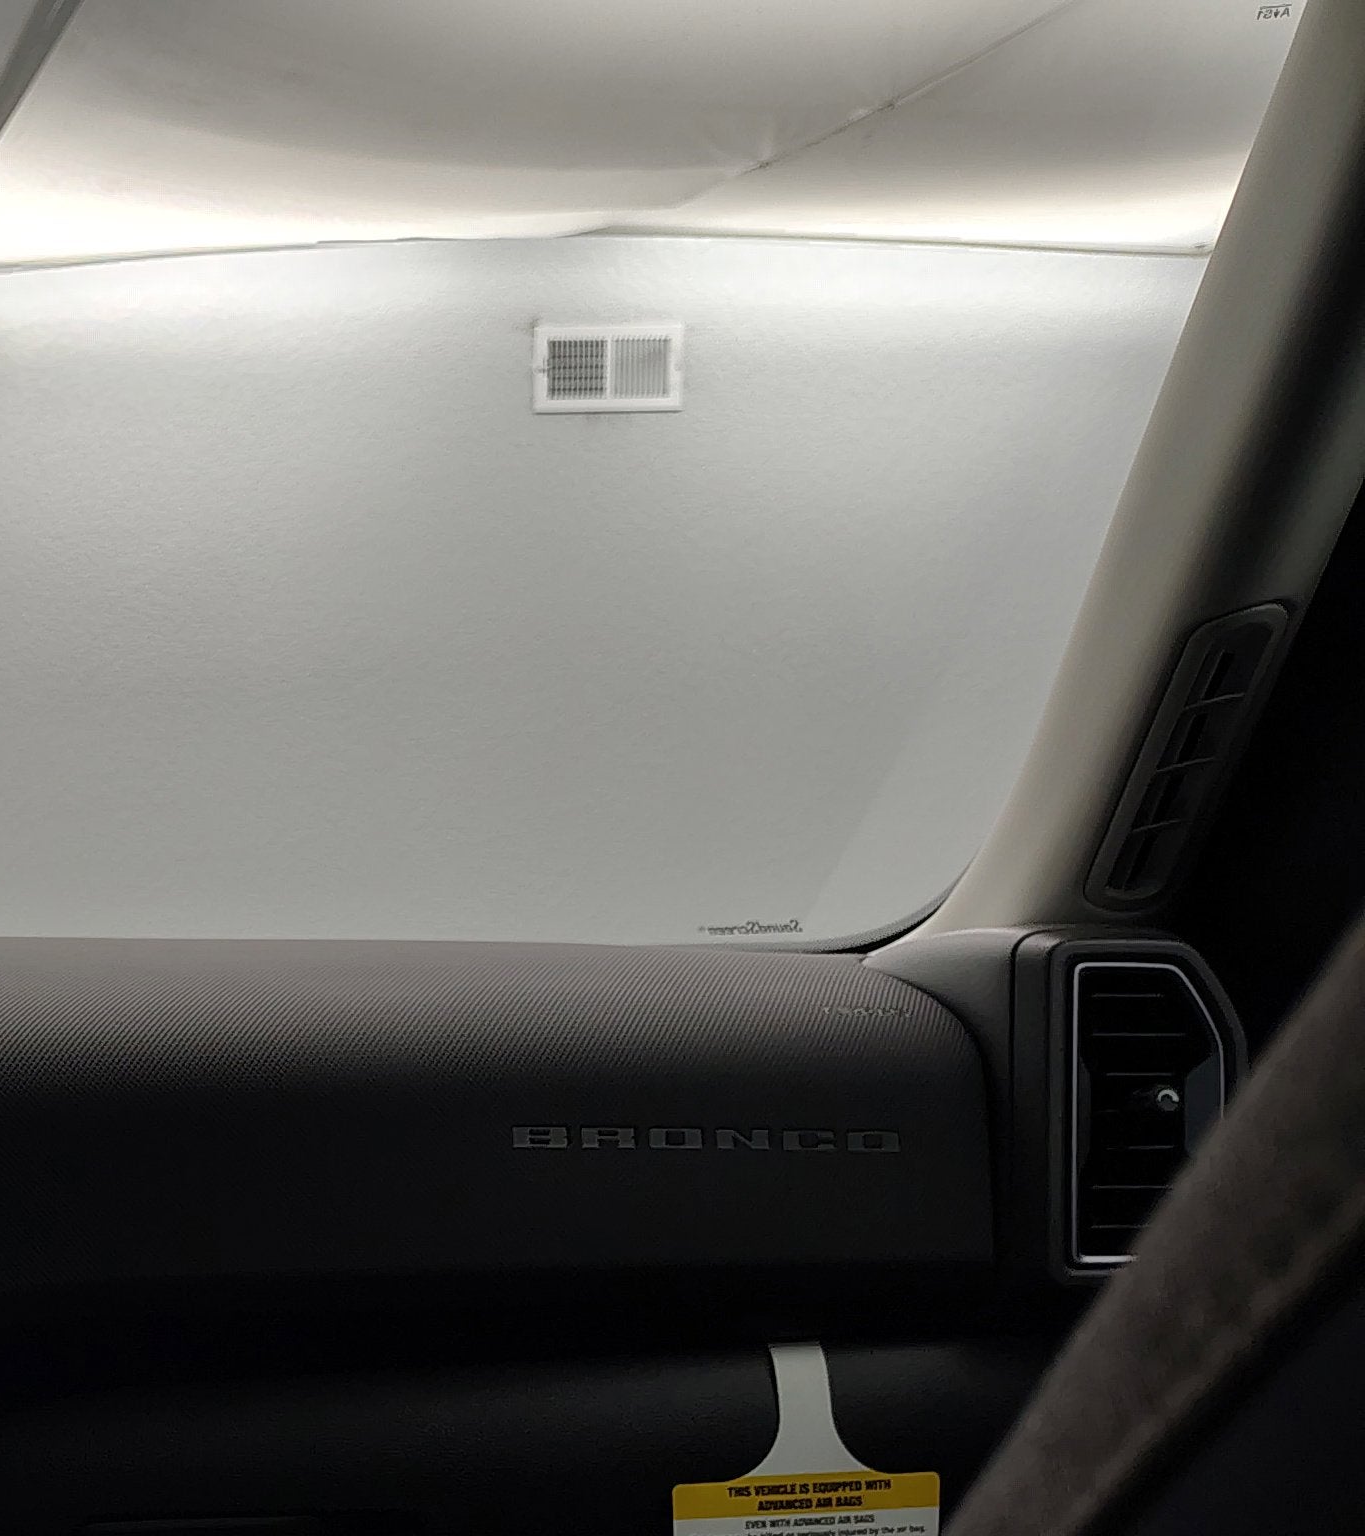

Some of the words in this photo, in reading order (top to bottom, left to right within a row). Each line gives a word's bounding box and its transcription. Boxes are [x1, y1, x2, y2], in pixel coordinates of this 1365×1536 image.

[511, 1126, 901, 1153] BRONCO
[727, 1486, 751, 1498] THIS
[754, 1484, 797, 1496] VEHICLE
[799, 1483, 809, 1494] IS
[813, 1480, 862, 1494] EQUIPPED
[865, 1479, 891, 1490] WITH
